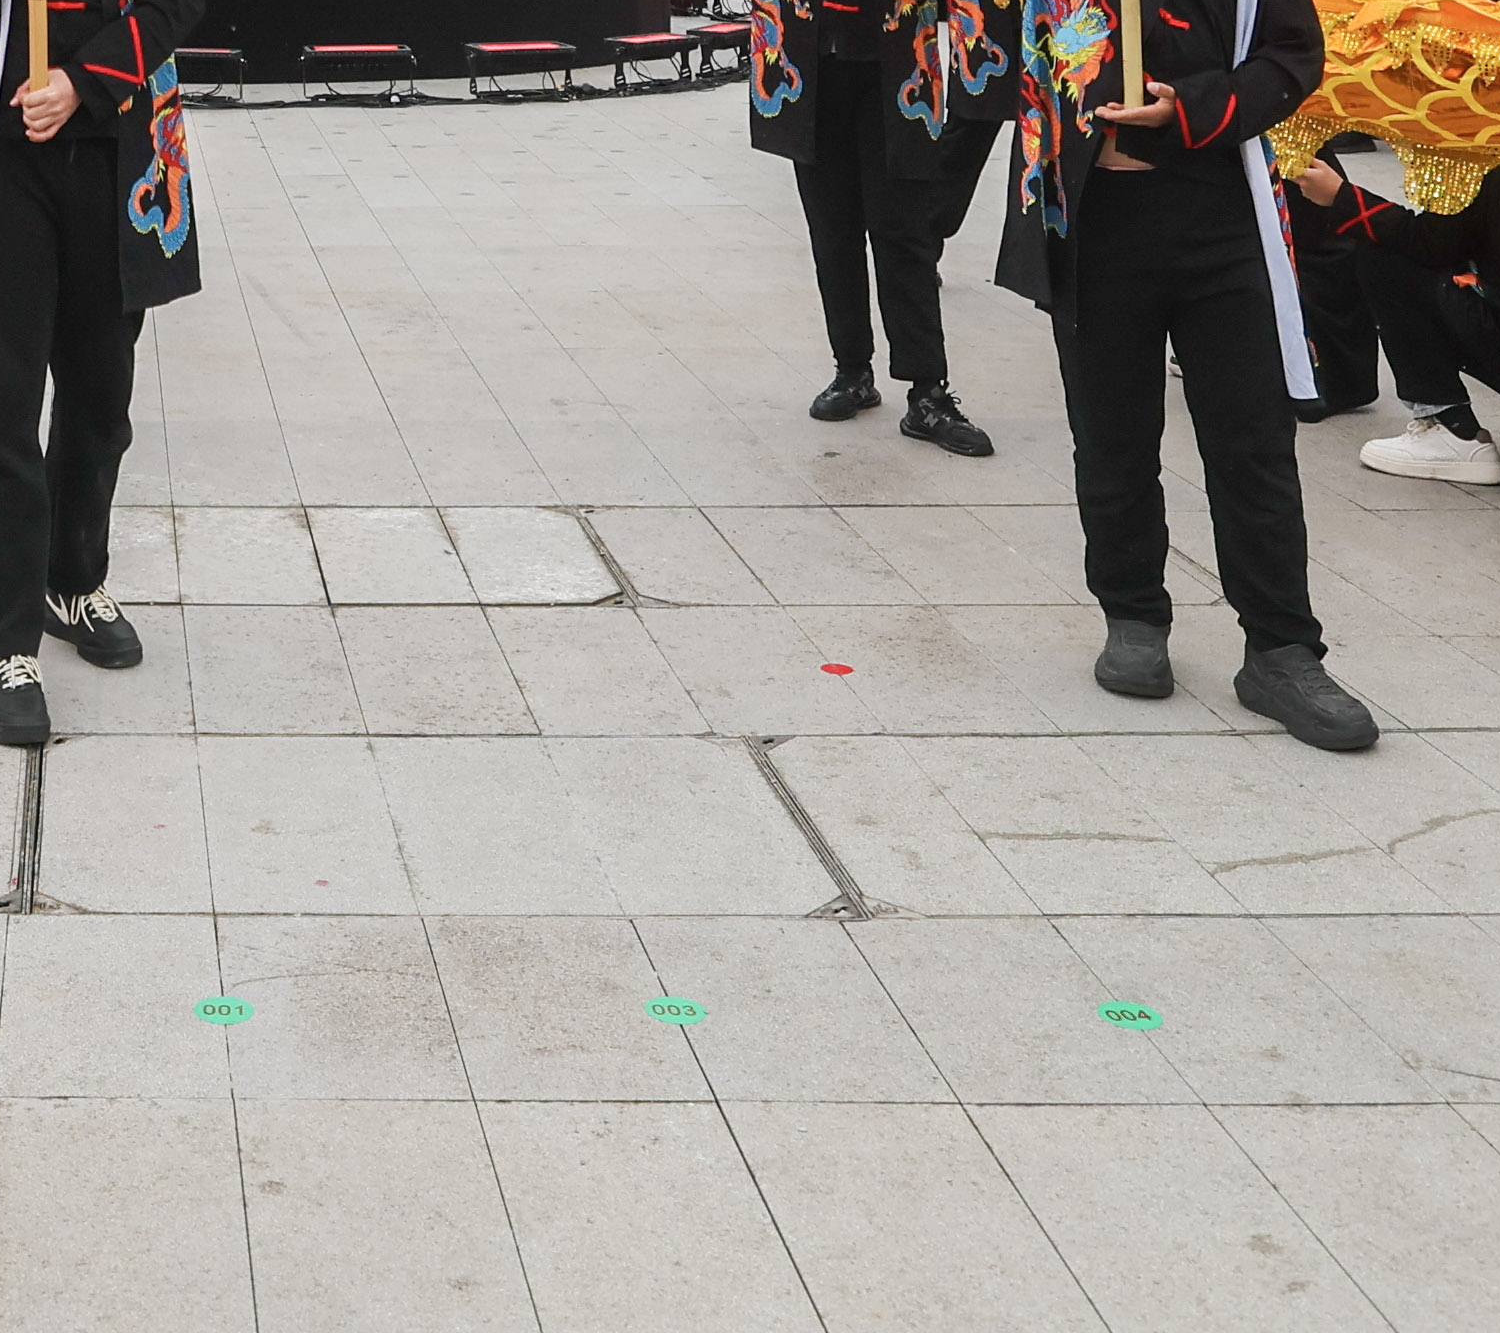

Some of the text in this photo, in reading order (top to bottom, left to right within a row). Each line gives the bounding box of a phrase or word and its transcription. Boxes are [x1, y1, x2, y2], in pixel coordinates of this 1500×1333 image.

[203, 1004, 243, 1016] 001
[652, 1004, 697, 1017] 003
[1105, 1009, 1152, 1022] 004
